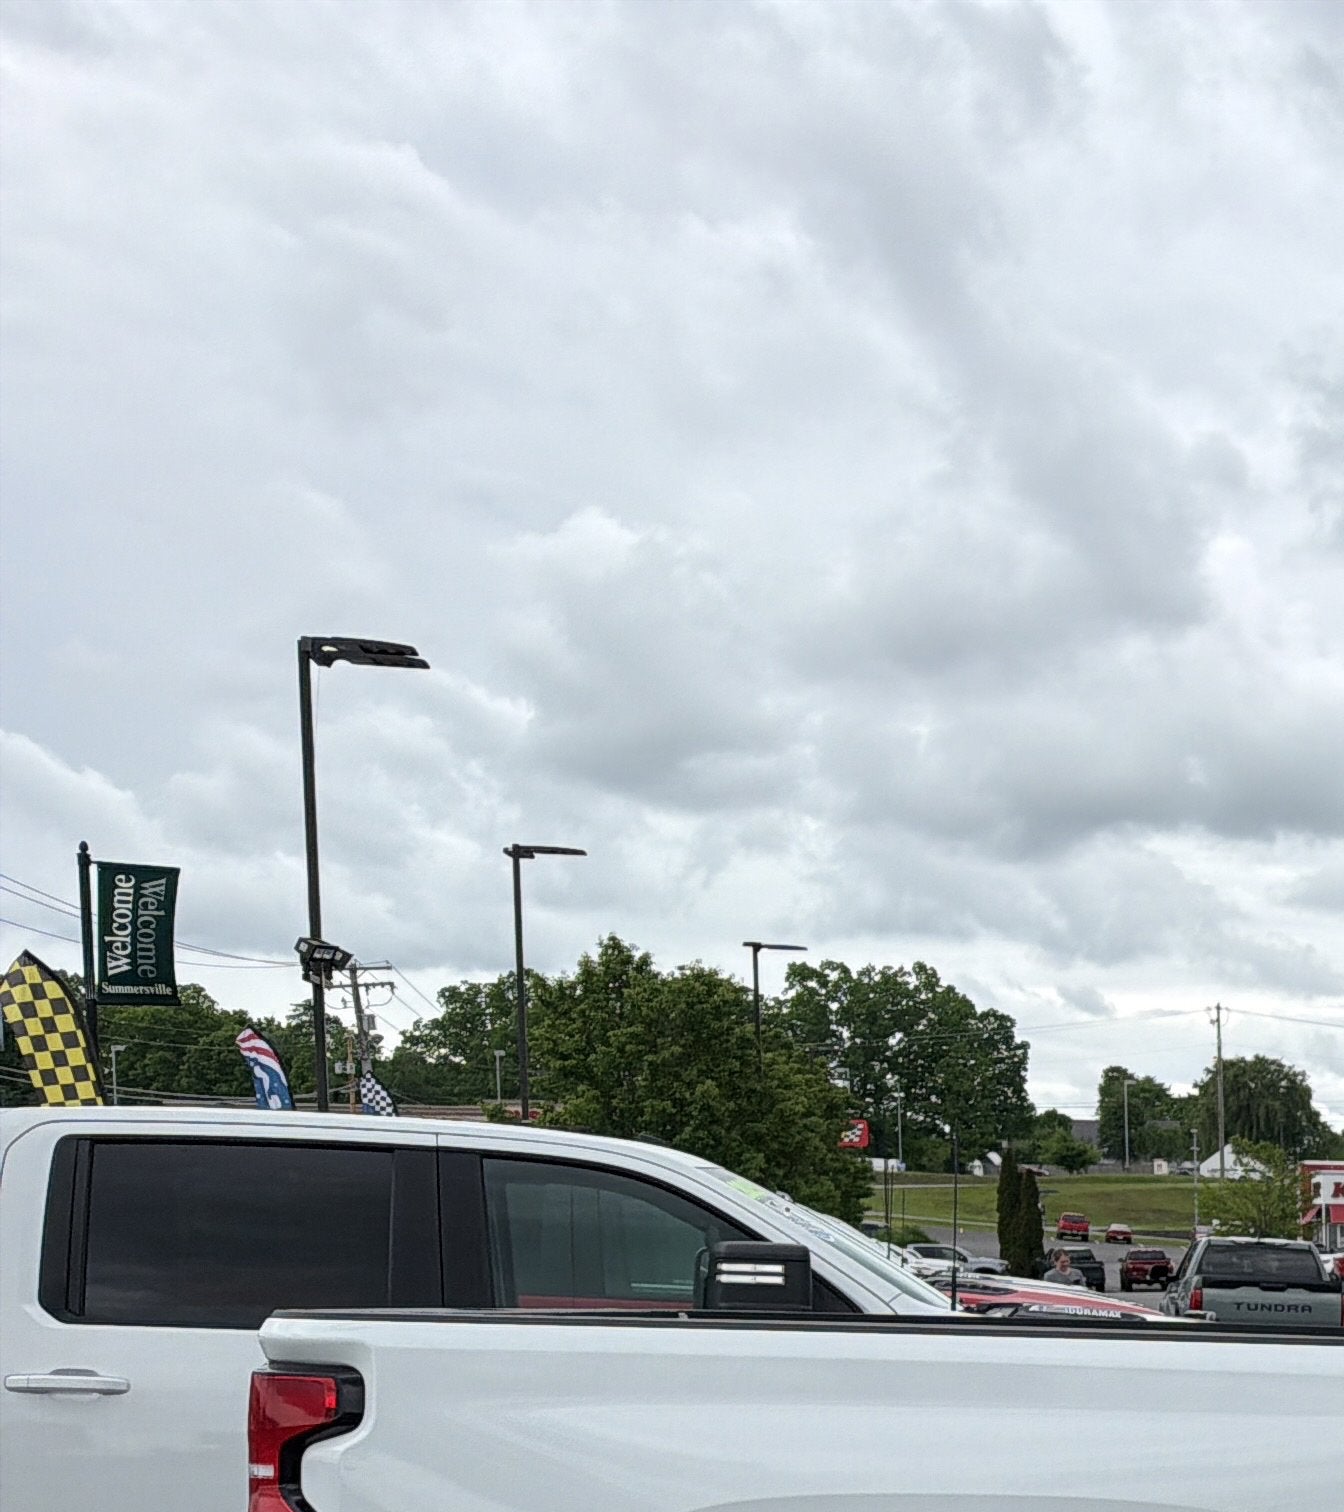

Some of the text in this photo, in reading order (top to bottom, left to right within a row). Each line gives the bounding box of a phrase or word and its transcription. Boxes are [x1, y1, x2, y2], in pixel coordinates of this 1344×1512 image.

[104, 874, 135, 977] Welcome
[136, 877, 167, 978] Welcome
[101, 981, 173, 995] Summersville
[1233, 1302, 1313, 1313] TUNDRA
